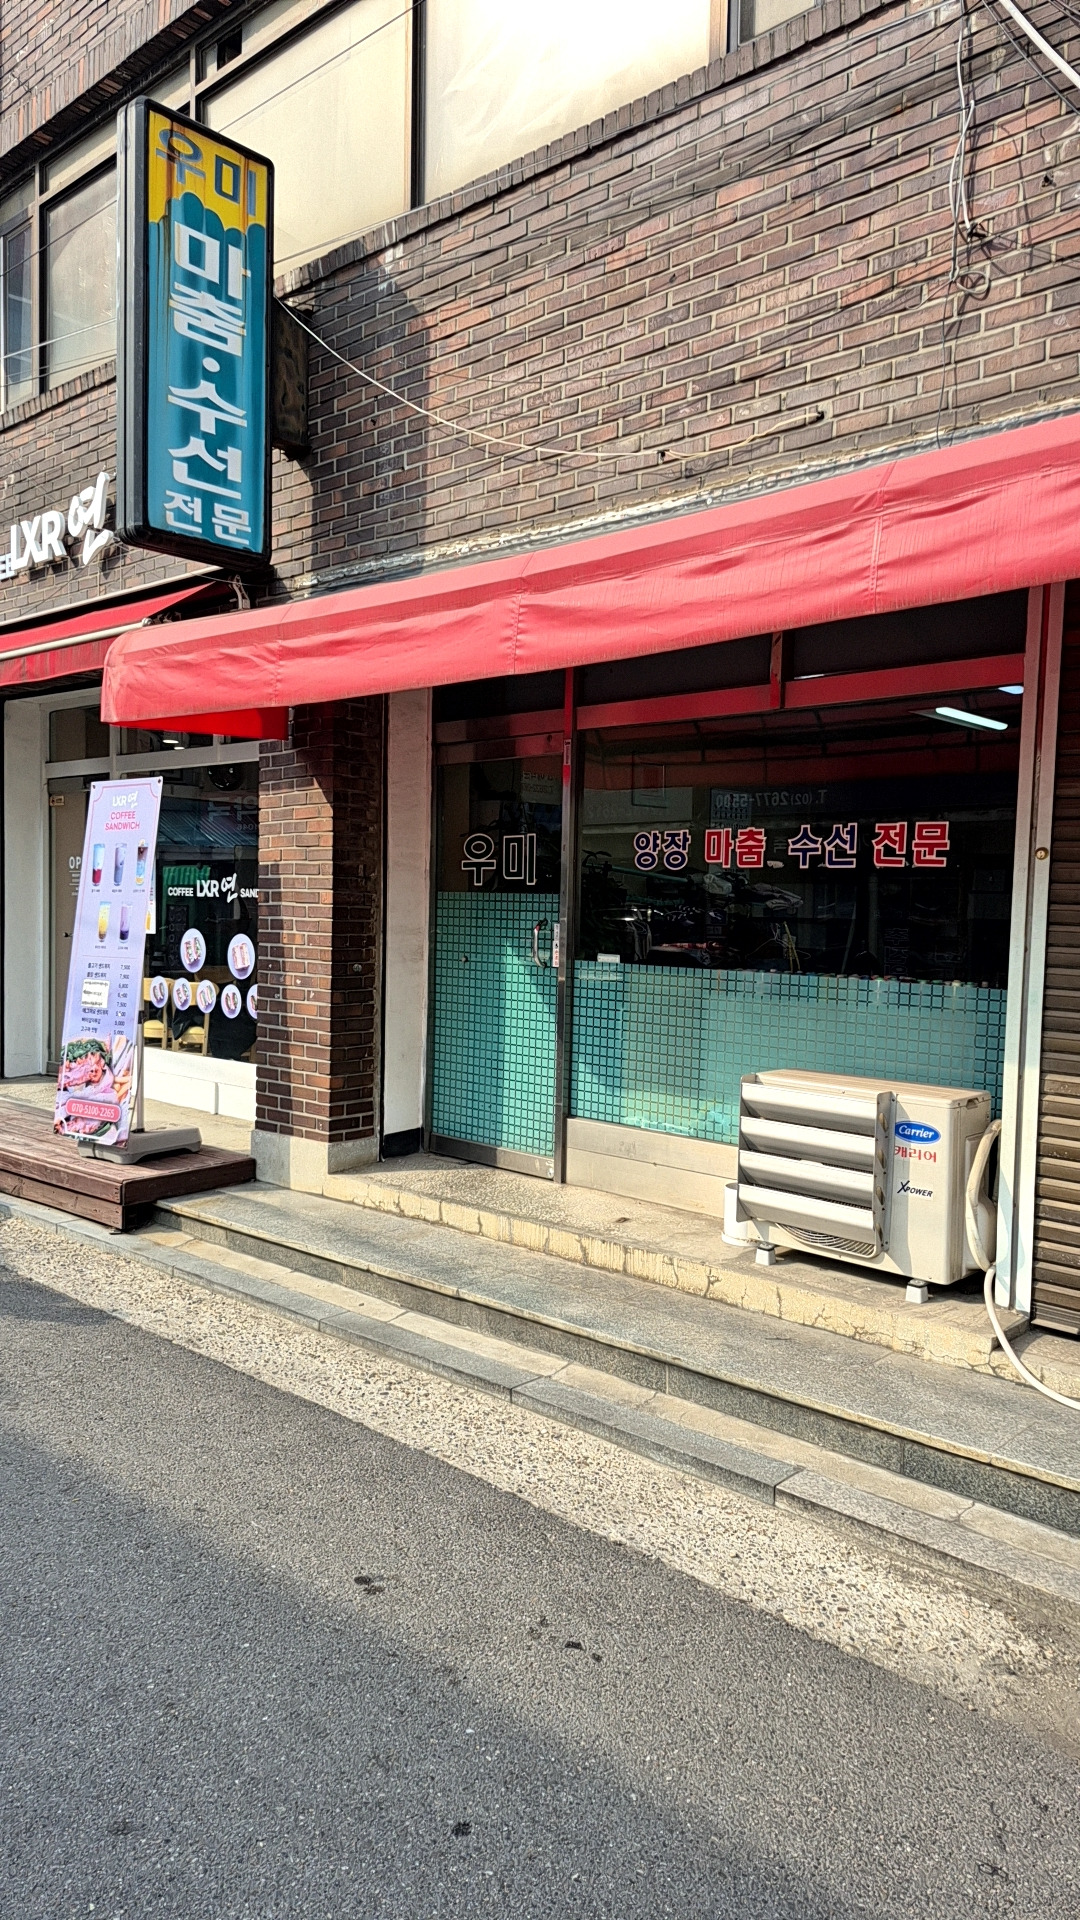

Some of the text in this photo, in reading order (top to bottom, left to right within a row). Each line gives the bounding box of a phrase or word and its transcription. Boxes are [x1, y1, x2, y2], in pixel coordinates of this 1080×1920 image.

[156, 128, 257, 217] 우미
[163, 490, 251, 545] 전문
[110, 811, 136, 820] COFFEE
[105, 822, 140, 831] SANDWICH
[633, 821, 950, 871] 양장 마춤 수선 전문
[461, 833, 537, 886] 우미
[167, 887, 194, 897] COFFEE
[71, 1103, 115, 1118] 070-5100-2265
[899, 1125, 935, 1139] Carrier
[894, 1145, 937, 1163] 캐리어
[897, 1180, 934, 1198] XPOWER
